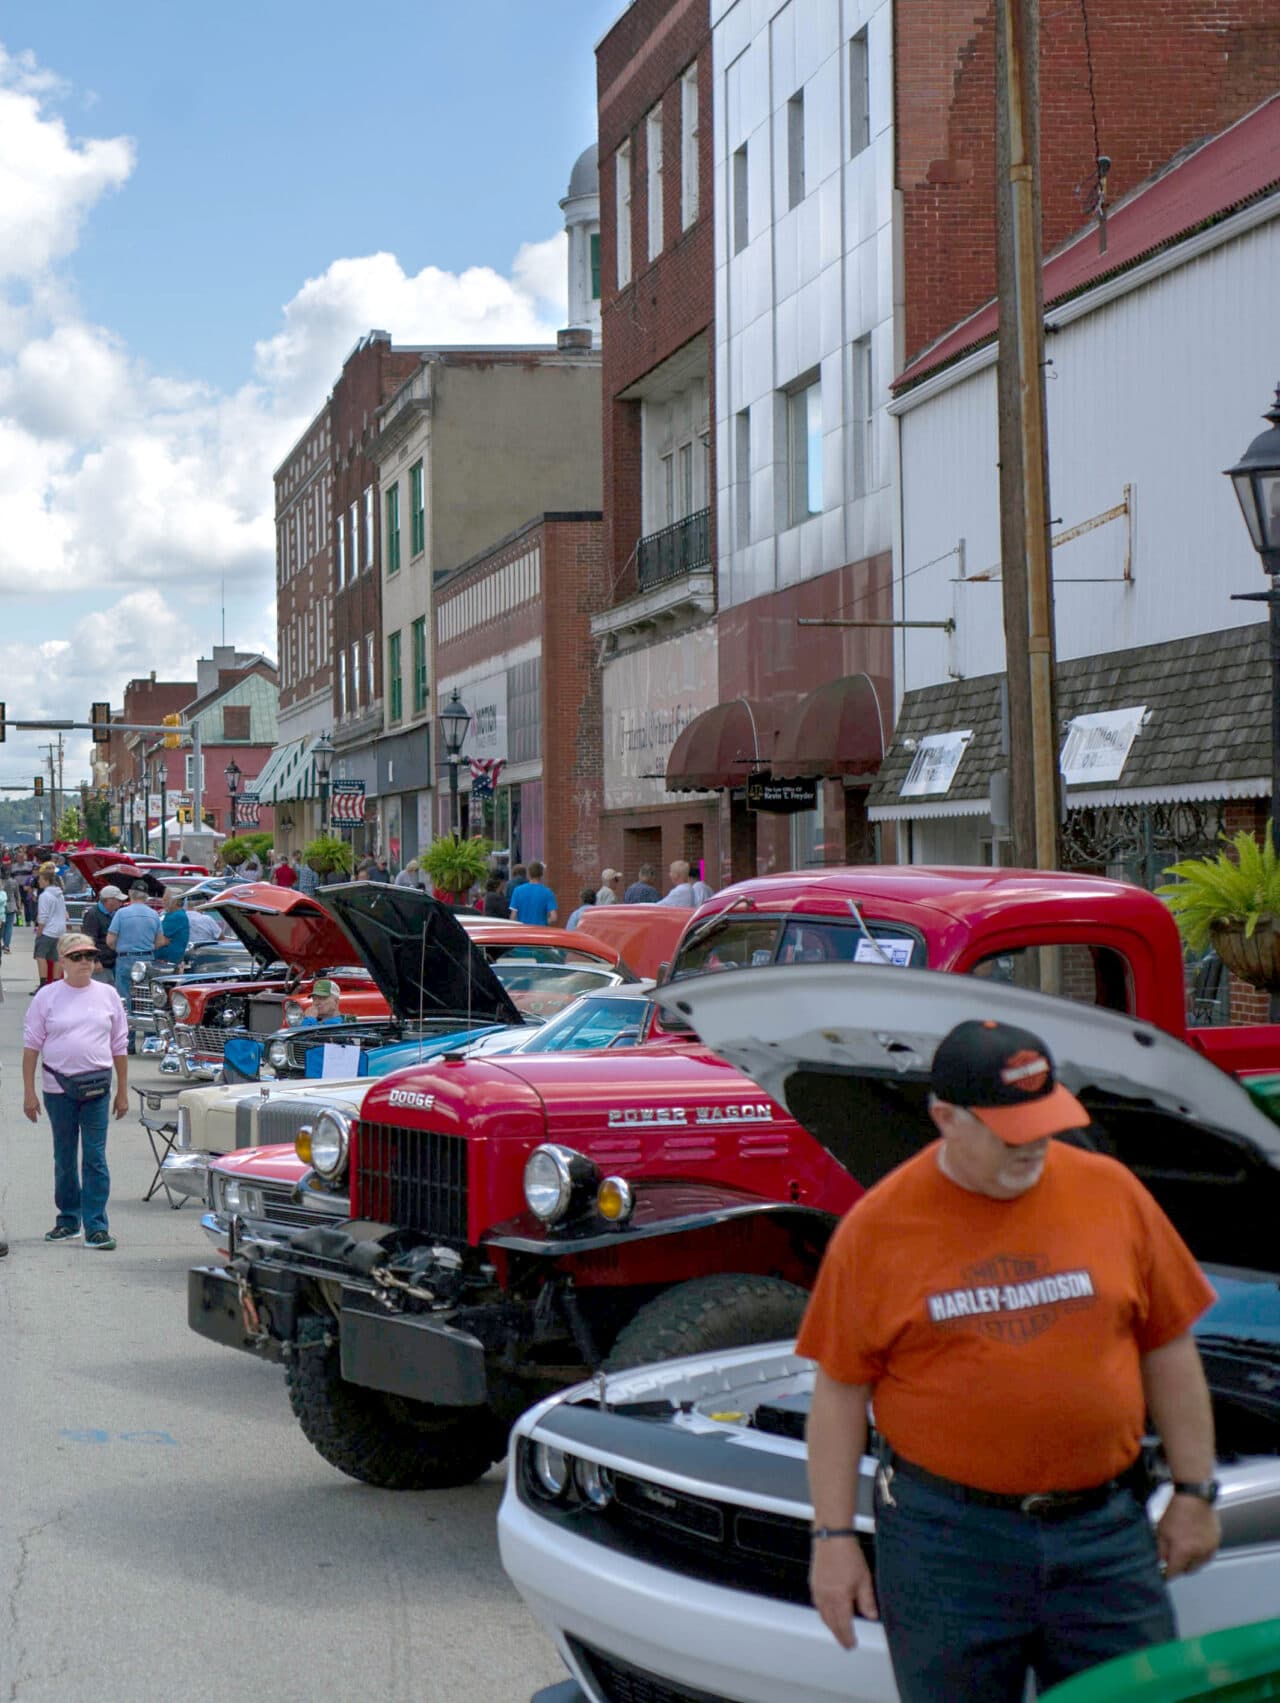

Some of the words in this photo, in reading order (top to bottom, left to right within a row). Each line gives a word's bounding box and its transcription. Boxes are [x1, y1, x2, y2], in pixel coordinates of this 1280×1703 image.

[389, 1088, 436, 1110] DODGE
[607, 1107, 687, 1127] POWER
[695, 1103, 772, 1124] WAGON
[931, 1269, 1095, 1322] HARLEY-DAVIDSON
